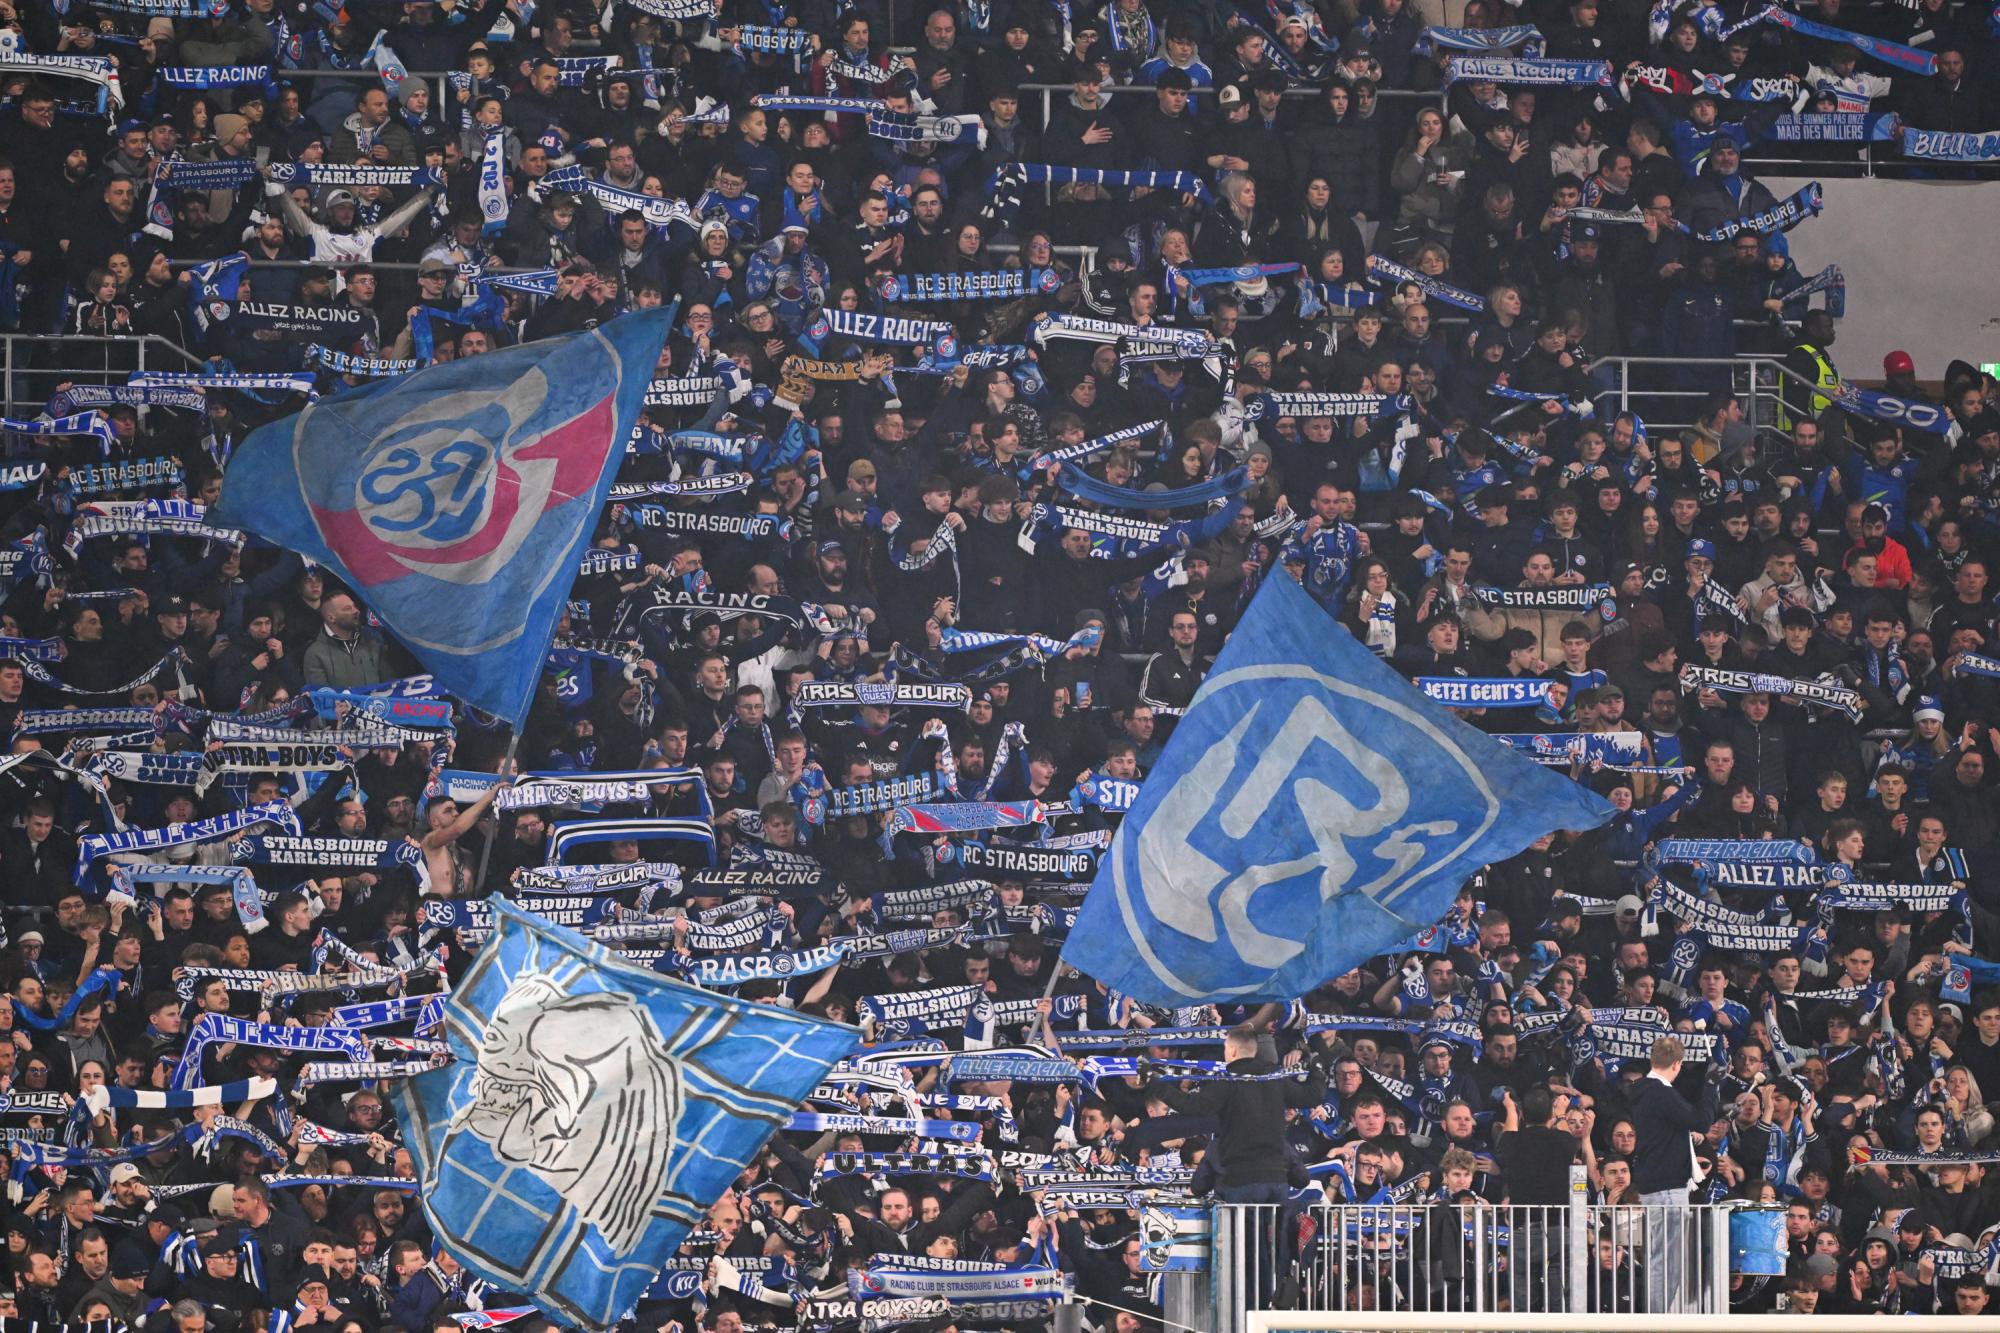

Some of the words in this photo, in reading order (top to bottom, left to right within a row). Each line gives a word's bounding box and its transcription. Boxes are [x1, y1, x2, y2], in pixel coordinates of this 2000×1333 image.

[157, 67, 206, 84] LLEZ
[209, 65, 268, 83] RACING
[1464, 56, 1510, 75] Allez
[1516, 57, 1579, 79] Racing
[1794, 113, 1804, 125] NE
[1806, 113, 1832, 125] SOMMES
[1833, 113, 1847, 125] PAS
[1848, 113, 1865, 125] ONZE
[1776, 125, 1801, 141] MAIS
[1803, 125, 1821, 141] DES
[1822, 125, 1864, 141] MILLIERS
[1913, 133, 1964, 156] BLEU
[173, 167, 239, 179] STRASBOURG
[310, 171, 413, 185] KARLSRUHE
[917, 277, 933, 291] RC
[937, 273, 1023, 290] STRASBOURG
[239, 301, 291, 318] ALLEZ
[294, 306, 361, 323] RACING
[323, 349, 417, 370] STRASBOURG
[75, 387, 112, 404] RACING
[117, 388, 145, 403] CLUB
[1277, 401, 1380, 417] KARLSRUHE
[1877, 397, 1939, 427] 90
[69, 469, 87, 486] RC
[90, 459, 178, 484] STRASBOURG
[682, 473, 745, 491] OUEST
[641, 507, 661, 527] RC
[666, 511, 773, 537] STRASBOURG
[1061, 515, 1162, 543] KARLSRUHE
[653, 589, 771, 609] RACING
[1503, 586, 1608, 606] STRASBOURG
[856, 683, 898, 694] TRIBUNE
[863, 691, 892, 701] OUEST
[1424, 681, 1468, 701] JETZT
[1529, 681, 1555, 699] LO
[392, 703, 446, 719] RACING
[202, 745, 271, 774] ULTRA
[277, 745, 338, 768] BOYS
[868, 760, 899, 774] hager
[451, 777, 489, 791] RACING
[833, 791, 850, 807] RC
[852, 776, 931, 805] STRASBOURG
[947, 802, 1006, 815] STRASBOURG
[956, 815, 987, 829] ALSACE
[262, 836, 388, 854] STRASBOURG
[1664, 841, 1724, 859] ALLEZ
[1722, 840, 1796, 859] RACING
[270, 850, 378, 867] KARLSRUHE
[963, 845, 982, 864] RC
[985, 849, 1088, 874] STRASBOURG
[690, 871, 746, 885] ALLEZ
[750, 871, 821, 885] RACING
[1717, 862, 1777, 887] ALLEZ
[1838, 883, 1958, 898] STRASBOURG
[887, 930, 926, 943] TRIBUNE
[893, 937, 923, 950] OUEST
[958, 1058, 1014, 1075] ALLEZ
[1015, 1059, 1081, 1077] RACING
[832, 1153, 984, 1177] ULTRAS
[877, 1252, 1007, 1272] STRASBOURG
[675, 1275, 697, 1292] KSC
[890, 1279, 916, 1292] RACING
[916, 1280, 935, 1292] CLUB
[936, 1280, 945, 1292] DE
[946, 1280, 992, 1292] STRASBOURG
[993, 1279, 1020, 1290] ALSACE
